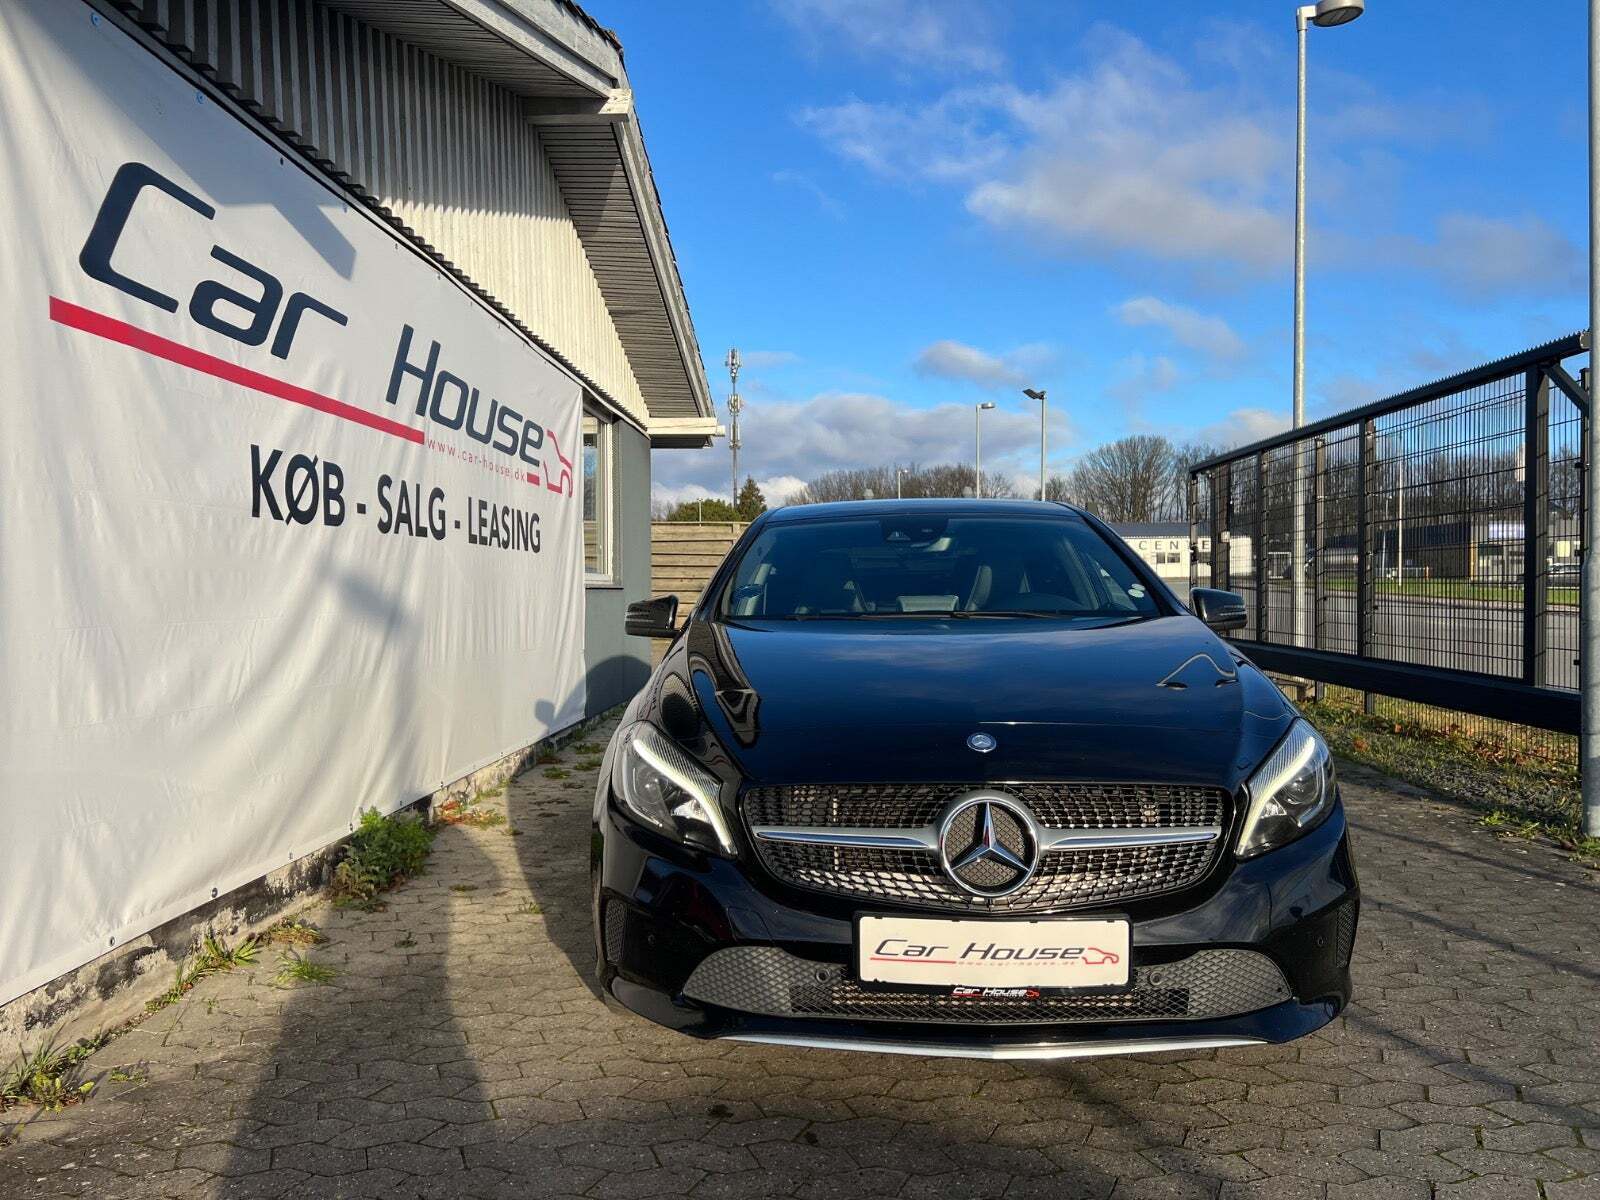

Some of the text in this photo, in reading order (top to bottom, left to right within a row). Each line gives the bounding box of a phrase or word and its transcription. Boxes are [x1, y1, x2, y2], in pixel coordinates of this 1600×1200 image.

[79, 161, 545, 467] Car House
[427, 438, 526, 484] www.car-house.dk
[250, 443, 346, 528] KØB
[376, 473, 447, 541] SALG
[467, 496, 542, 554] LEASING
[874, 938, 1085, 960] Car House
[952, 986, 1027, 997] Car House
